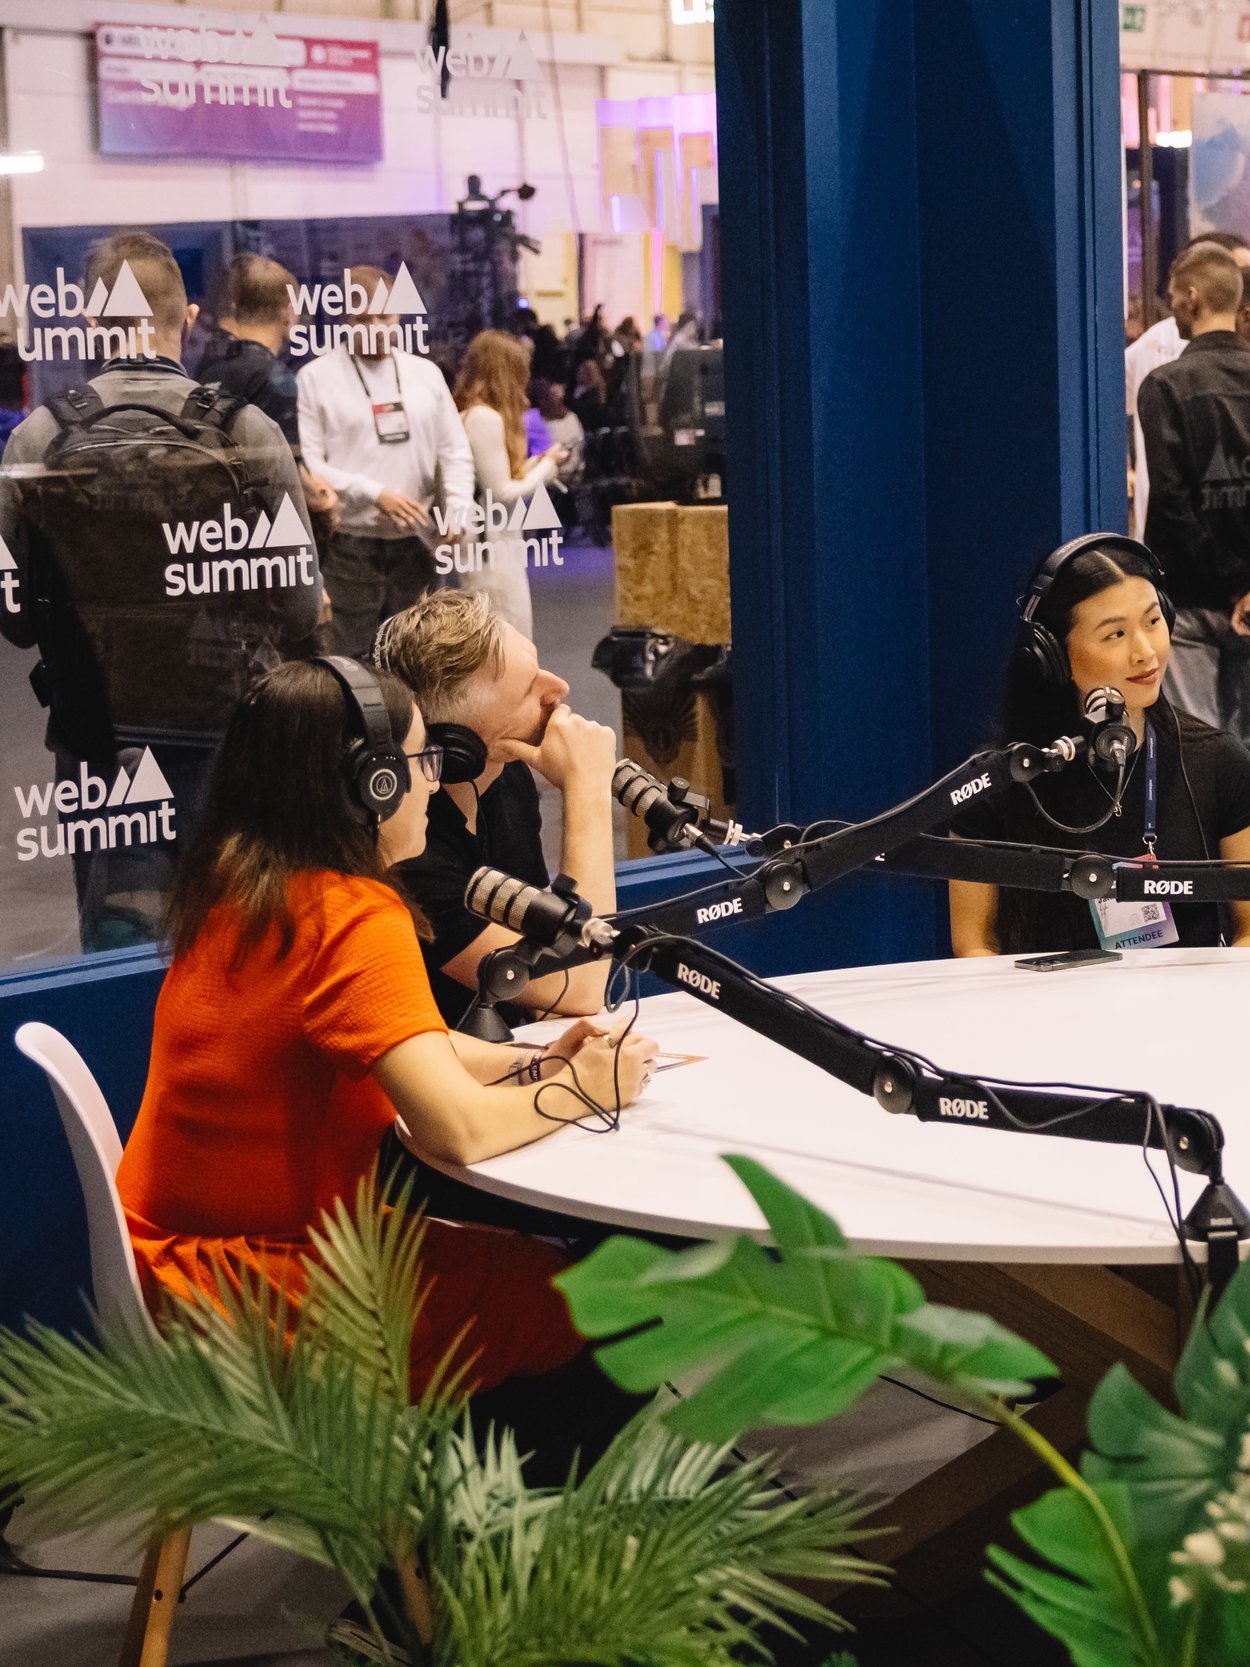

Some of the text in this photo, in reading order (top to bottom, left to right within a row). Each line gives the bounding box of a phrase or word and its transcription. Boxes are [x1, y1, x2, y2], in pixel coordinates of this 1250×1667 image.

[135, 14, 223, 62] web
[415, 32, 488, 78] web
[139, 69, 292, 109] summit
[416, 84, 547, 119] summit
[0, 267, 84, 318] web
[286, 268, 368, 316] web
[289, 316, 429, 356] summit
[162, 503, 249, 554] web
[433, 488, 508, 536] web
[164, 547, 314, 597] summit
[435, 530, 564, 575] summit
[14, 761, 107, 818] web
[949, 772, 992, 806] RØDE
[16, 800, 177, 861] summit
[1143, 880, 1194, 895] RØDE
[696, 898, 743, 924] RØDE
[1115, 929, 1164, 949] ATTENDEE
[676, 962, 722, 1000] RØDE
[938, 1097, 990, 1120] RØDE
